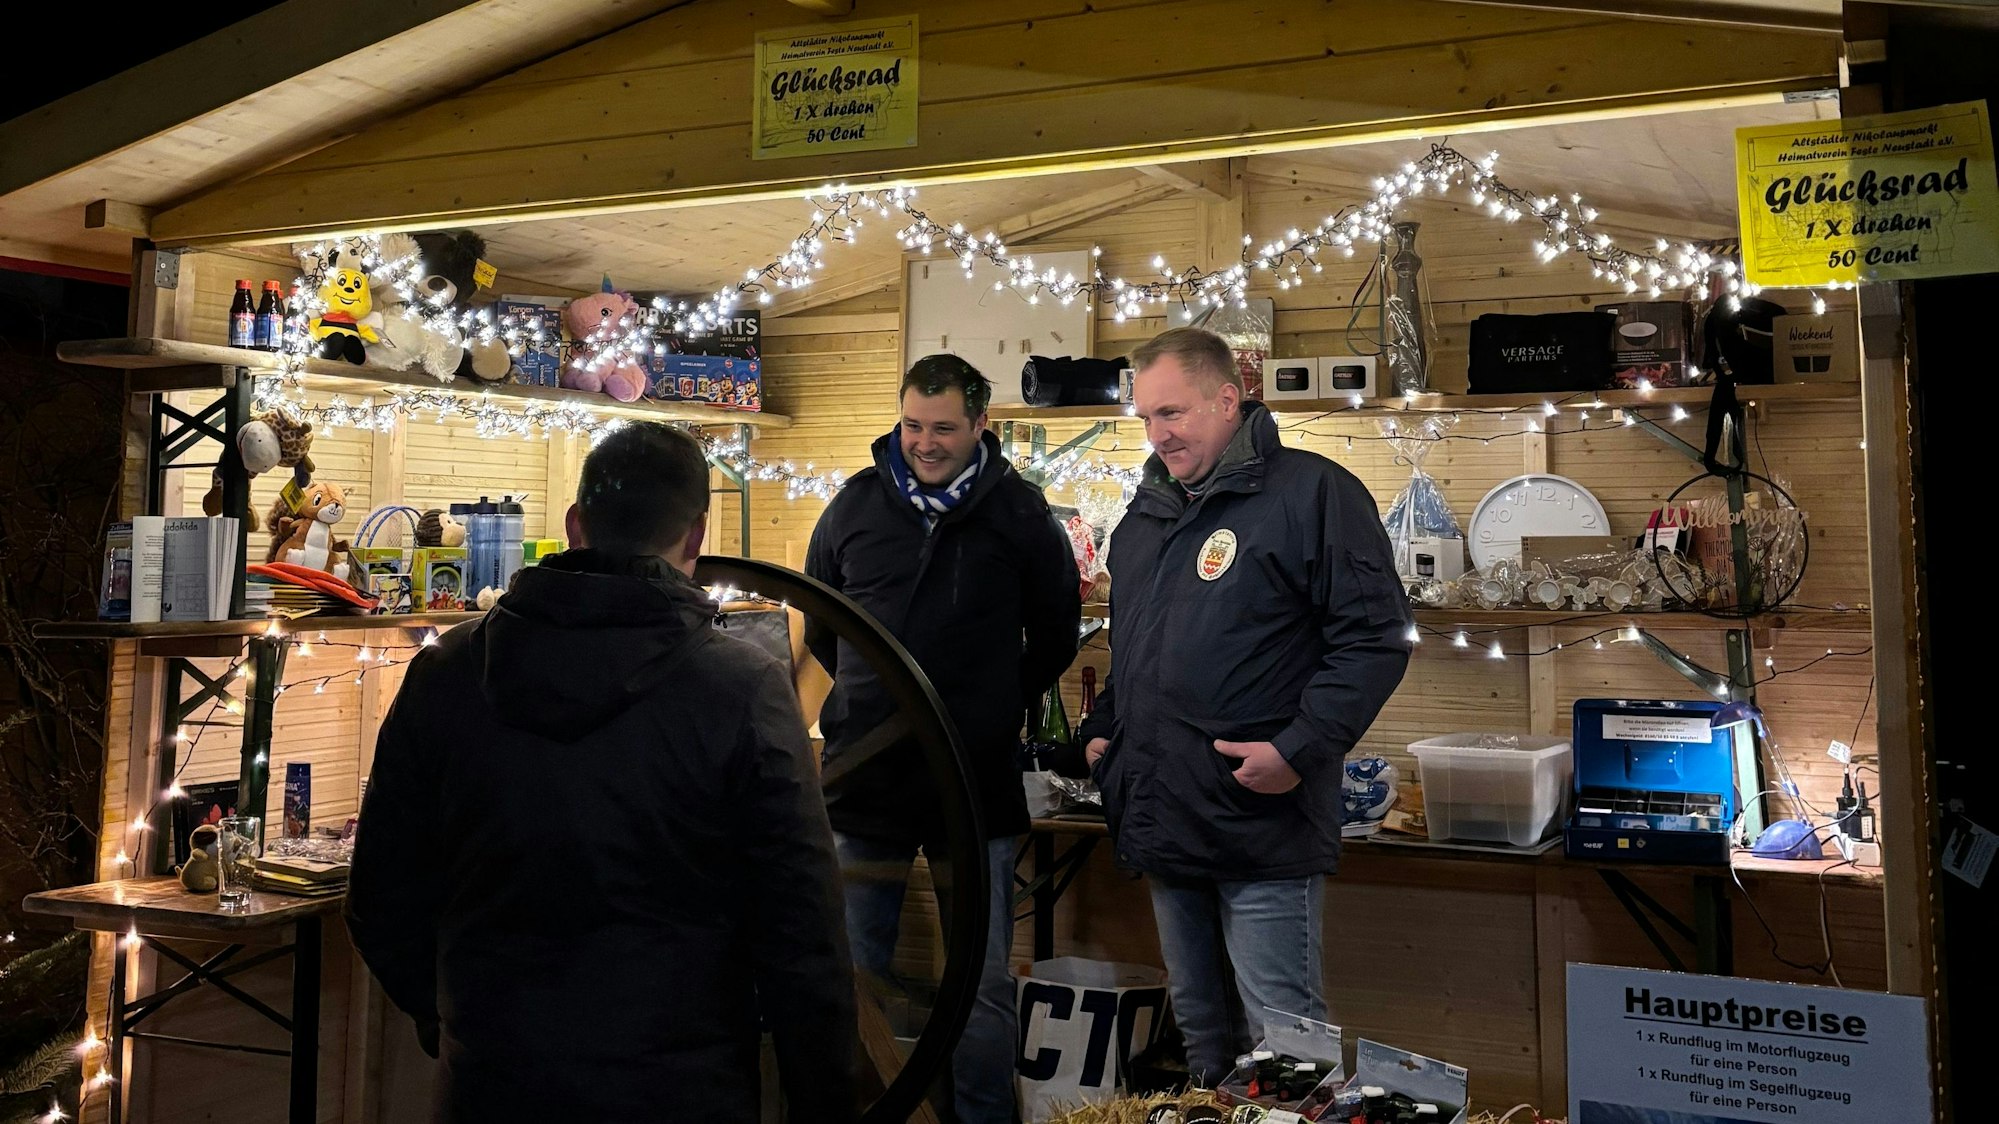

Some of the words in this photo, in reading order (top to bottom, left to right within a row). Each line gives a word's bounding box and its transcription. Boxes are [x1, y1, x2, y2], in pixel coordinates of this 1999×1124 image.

[781, 49, 826, 60] Heimatverein
[848, 43, 881, 53] Neustadt
[770, 58, 901, 101] Glücksrad
[794, 105, 802, 120] 1
[824, 101, 874, 118] drehen
[807, 128, 826, 144] 50
[830, 124, 865, 141] Cent
[1791, 132, 1849, 148] Altstädter
[1852, 122, 1938, 142] Nikolausmarkt
[1778, 147, 1848, 163] Heimatverein
[1850, 144, 1878, 157] Feste
[1882, 138, 1935, 154] Neustadt
[1937, 135, 1955, 147] e.V.
[1765, 157, 1969, 214] Glücksrad
[1806, 221, 1816, 239] 1
[1851, 211, 1932, 236] drehen
[1828, 249, 1856, 269] 50
[1865, 243, 1920, 266] Cent
[1789, 325, 1834, 342] Weekend
[1501, 344, 1565, 358] VERSACE
[1507, 354, 1558, 363] PARFUMS
[1512, 490, 1528, 507] 11
[1536, 485, 1557, 502] 12
[1568, 494, 1576, 511] 1
[1490, 507, 1513, 524] 10
[1581, 513, 1597, 530] 2
[1661, 491, 1810, 532] Willkommen
[164, 521, 199, 532] udokids
[1480, 530, 1495, 545] 9
[1625, 987, 1867, 1037] Hauptpreise
[1636, 1030, 1643, 1041] 1
[1647, 1032, 1655, 1042] x
[1659, 1031, 1722, 1053] Rundflug
[1726, 1038, 1744, 1052] im
[1747, 1041, 1851, 1067] Motorflugzeug
[1690, 1053, 1710, 1067] für
[1713, 1057, 1743, 1071] eine
[1747, 1060, 1798, 1077] Person
[1637, 1067, 1645, 1078] 1
[1649, 1069, 1657, 1079] x
[1661, 1069, 1724, 1090] Rundflug
[1728, 1076, 1746, 1089] im
[1749, 1079, 1851, 1104] Segelflugzeug
[1689, 1091, 1709, 1104] für
[1713, 1095, 1742, 1108] eine
[1746, 1098, 1797, 1115] Person
